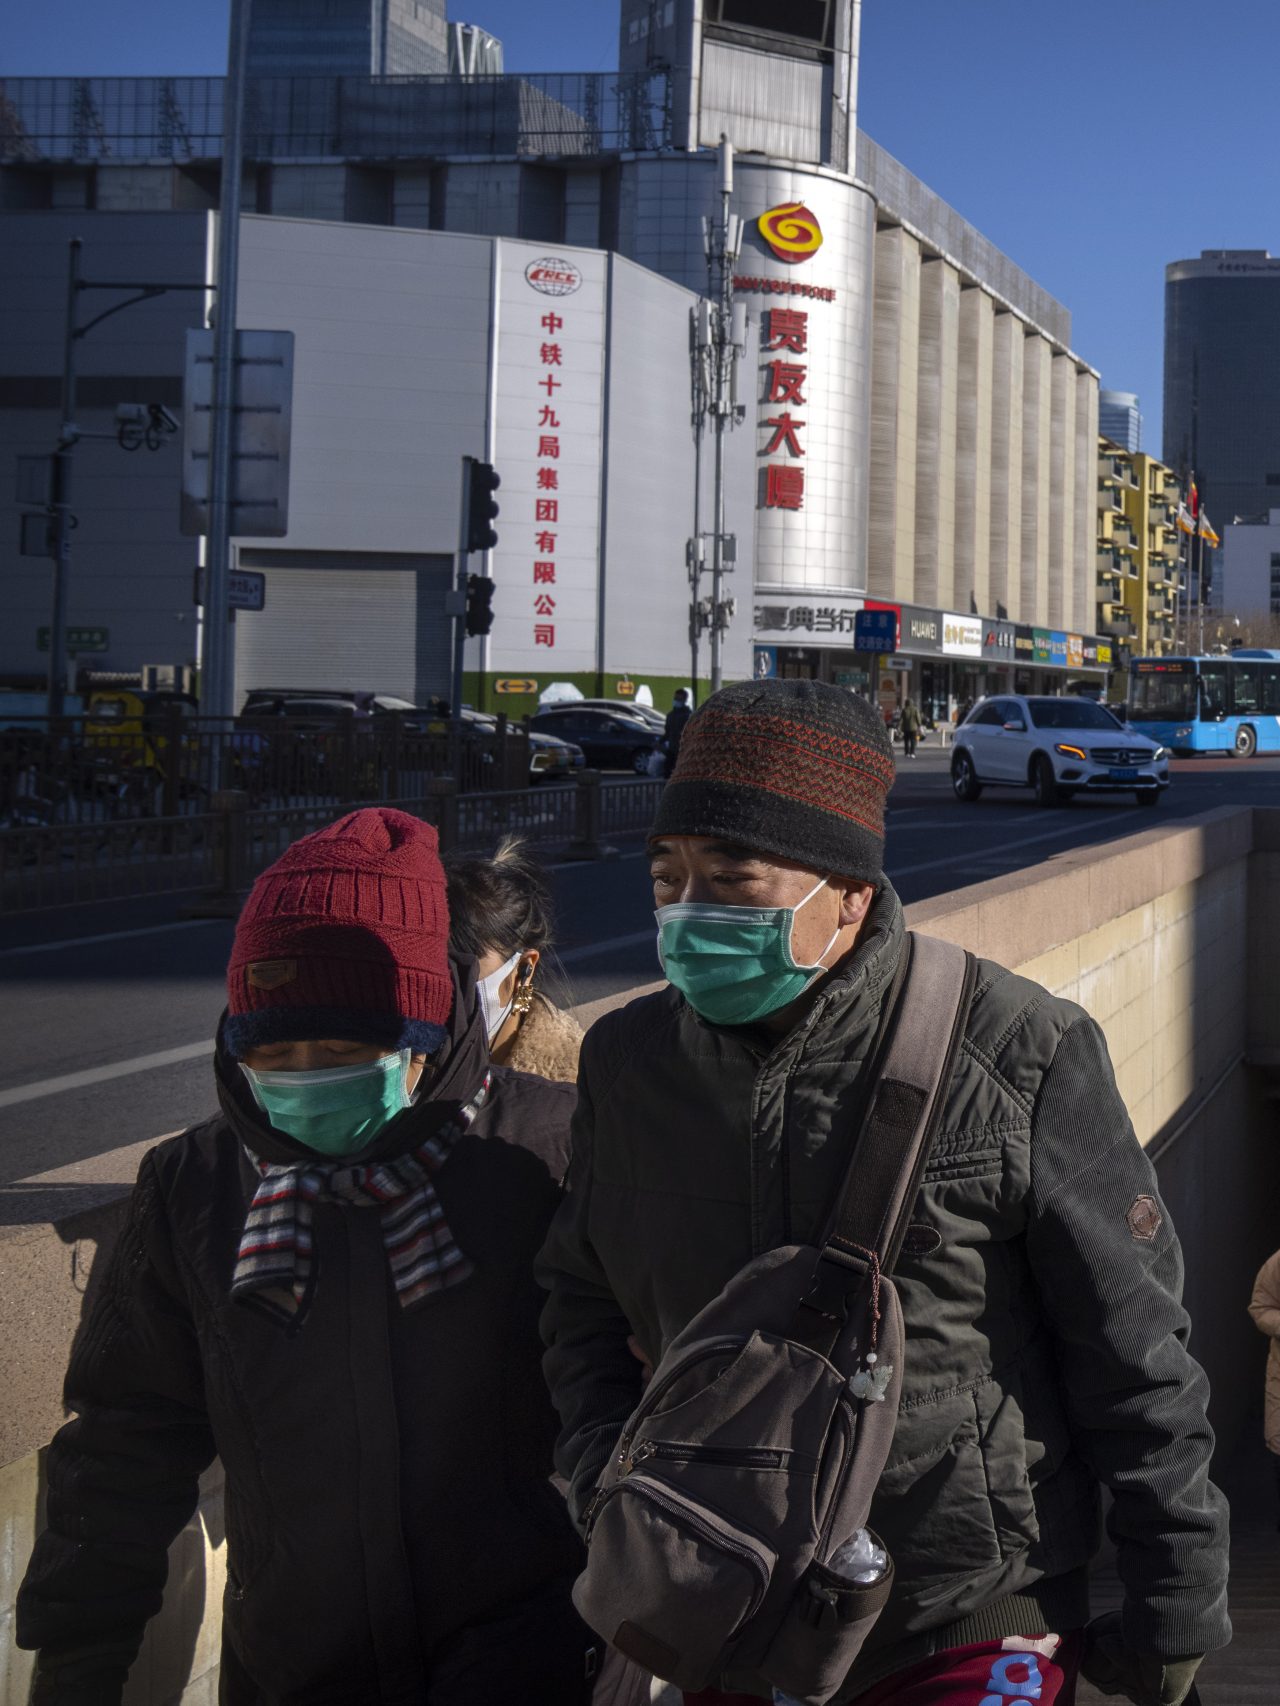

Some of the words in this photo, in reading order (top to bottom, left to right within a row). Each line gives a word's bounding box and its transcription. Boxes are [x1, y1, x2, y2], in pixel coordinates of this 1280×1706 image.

[765, 307, 808, 510] 贵友大厦
[533, 311, 564, 648] 中铁十九局集团有限公司
[754, 605, 856, 632] 夏典当行
[911, 620, 937, 641] HUAWEI
